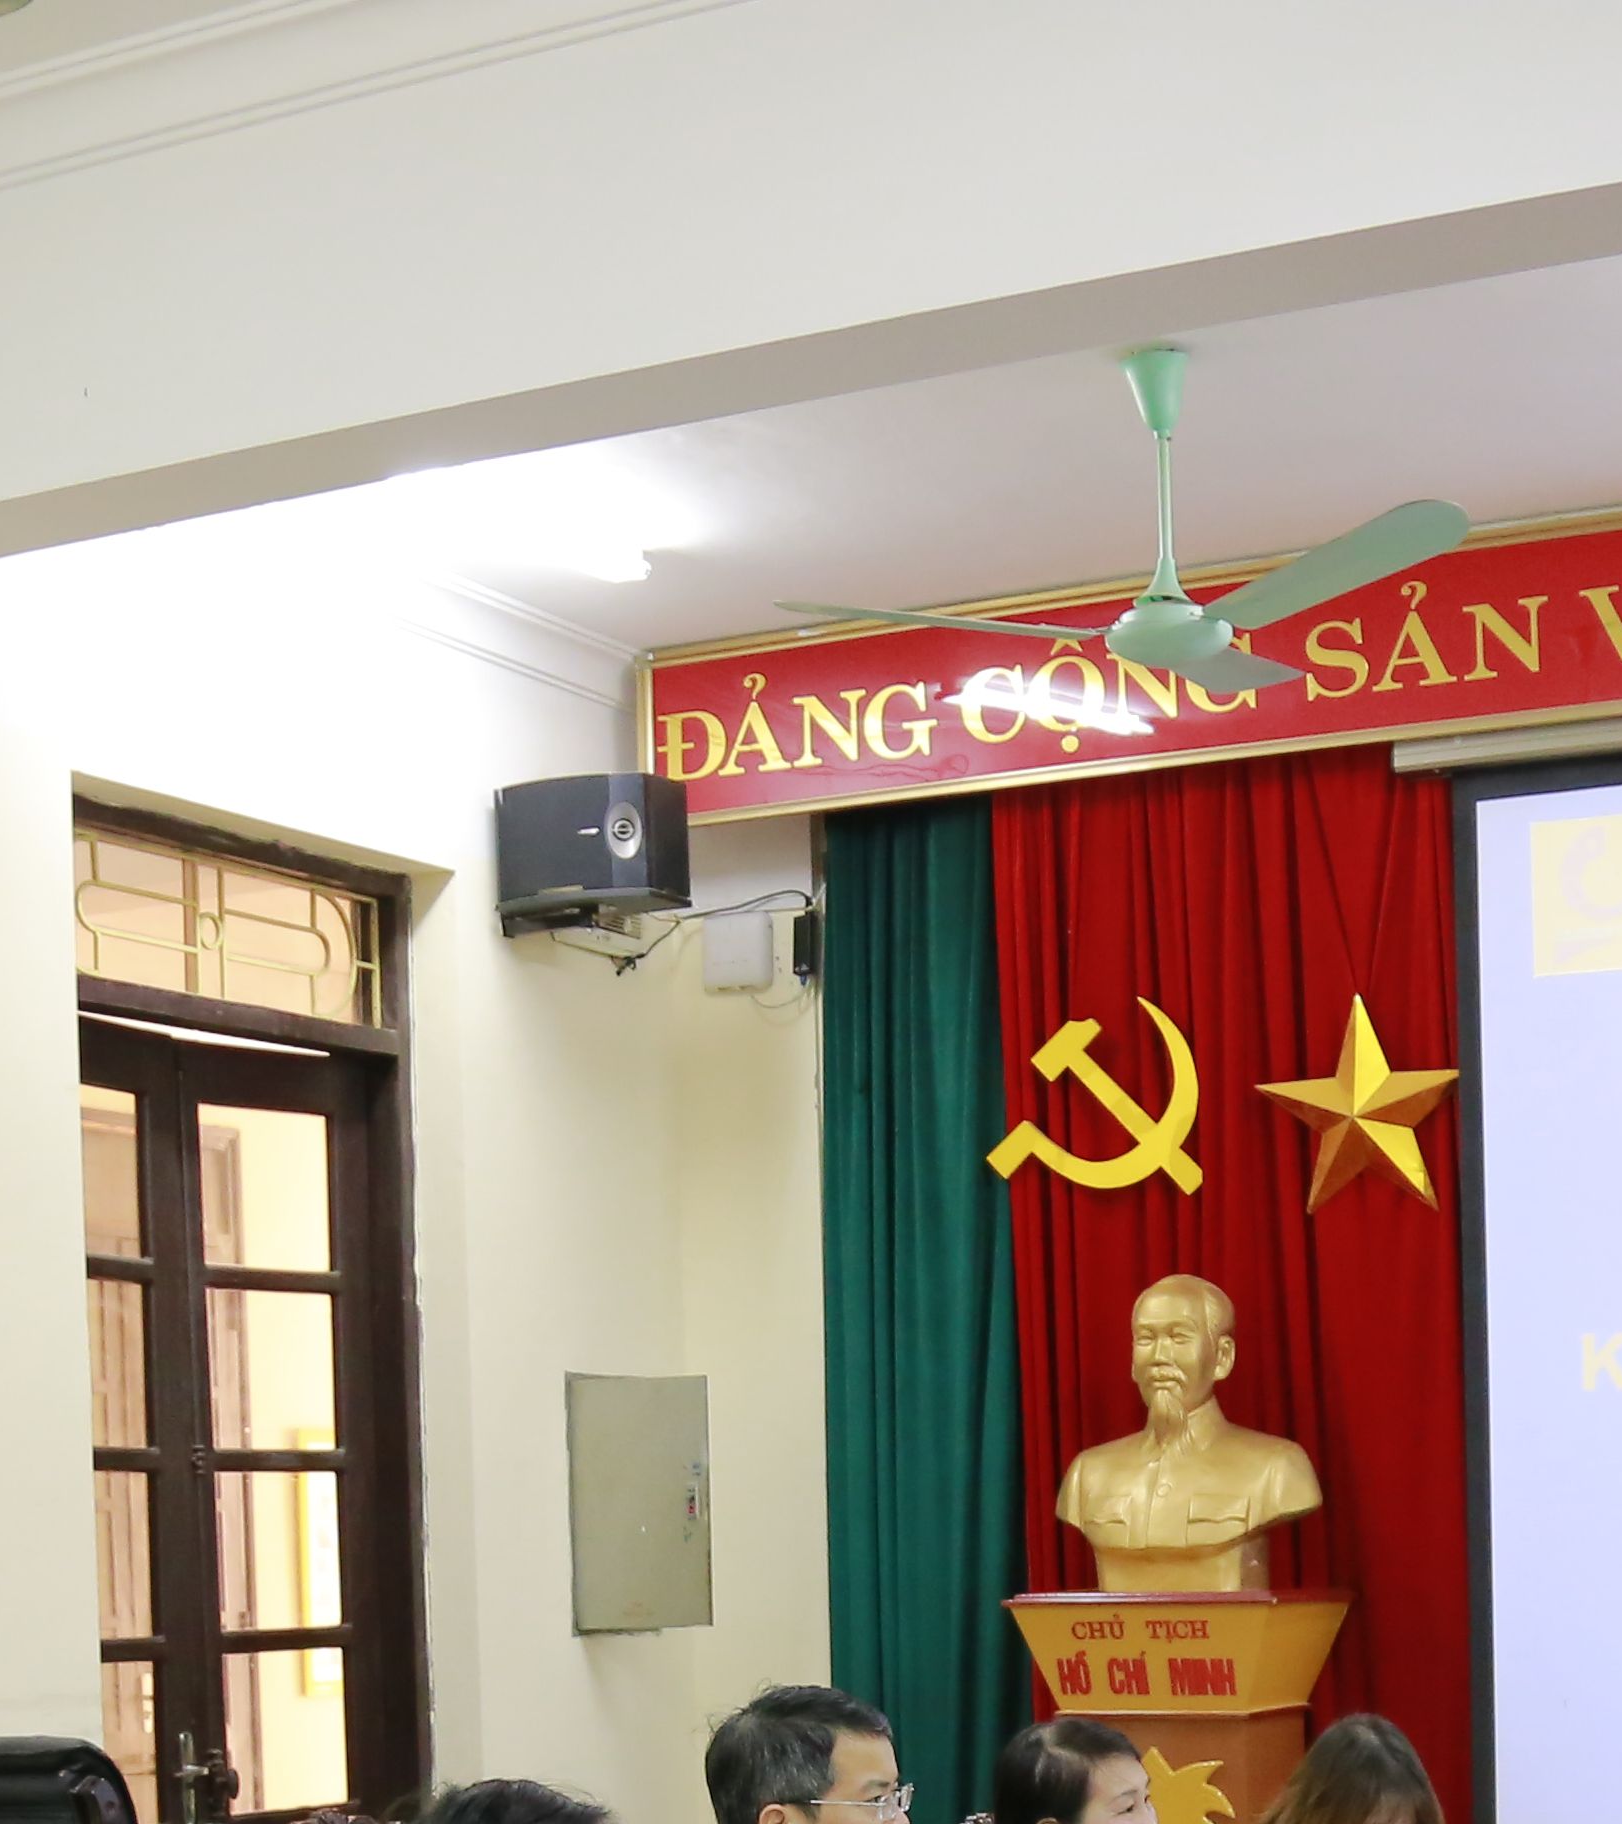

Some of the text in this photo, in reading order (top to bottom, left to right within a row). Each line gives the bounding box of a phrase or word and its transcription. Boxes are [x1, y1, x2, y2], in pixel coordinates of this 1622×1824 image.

[657, 673, 939, 782] ĐẢNG
[1305, 582, 1544, 699] SẢN
[1071, 1613, 1211, 1644] CHỦ TỊCH
[1107, 1651, 1151, 1696] CHÍ
[1167, 1658, 1237, 1696] MINH
